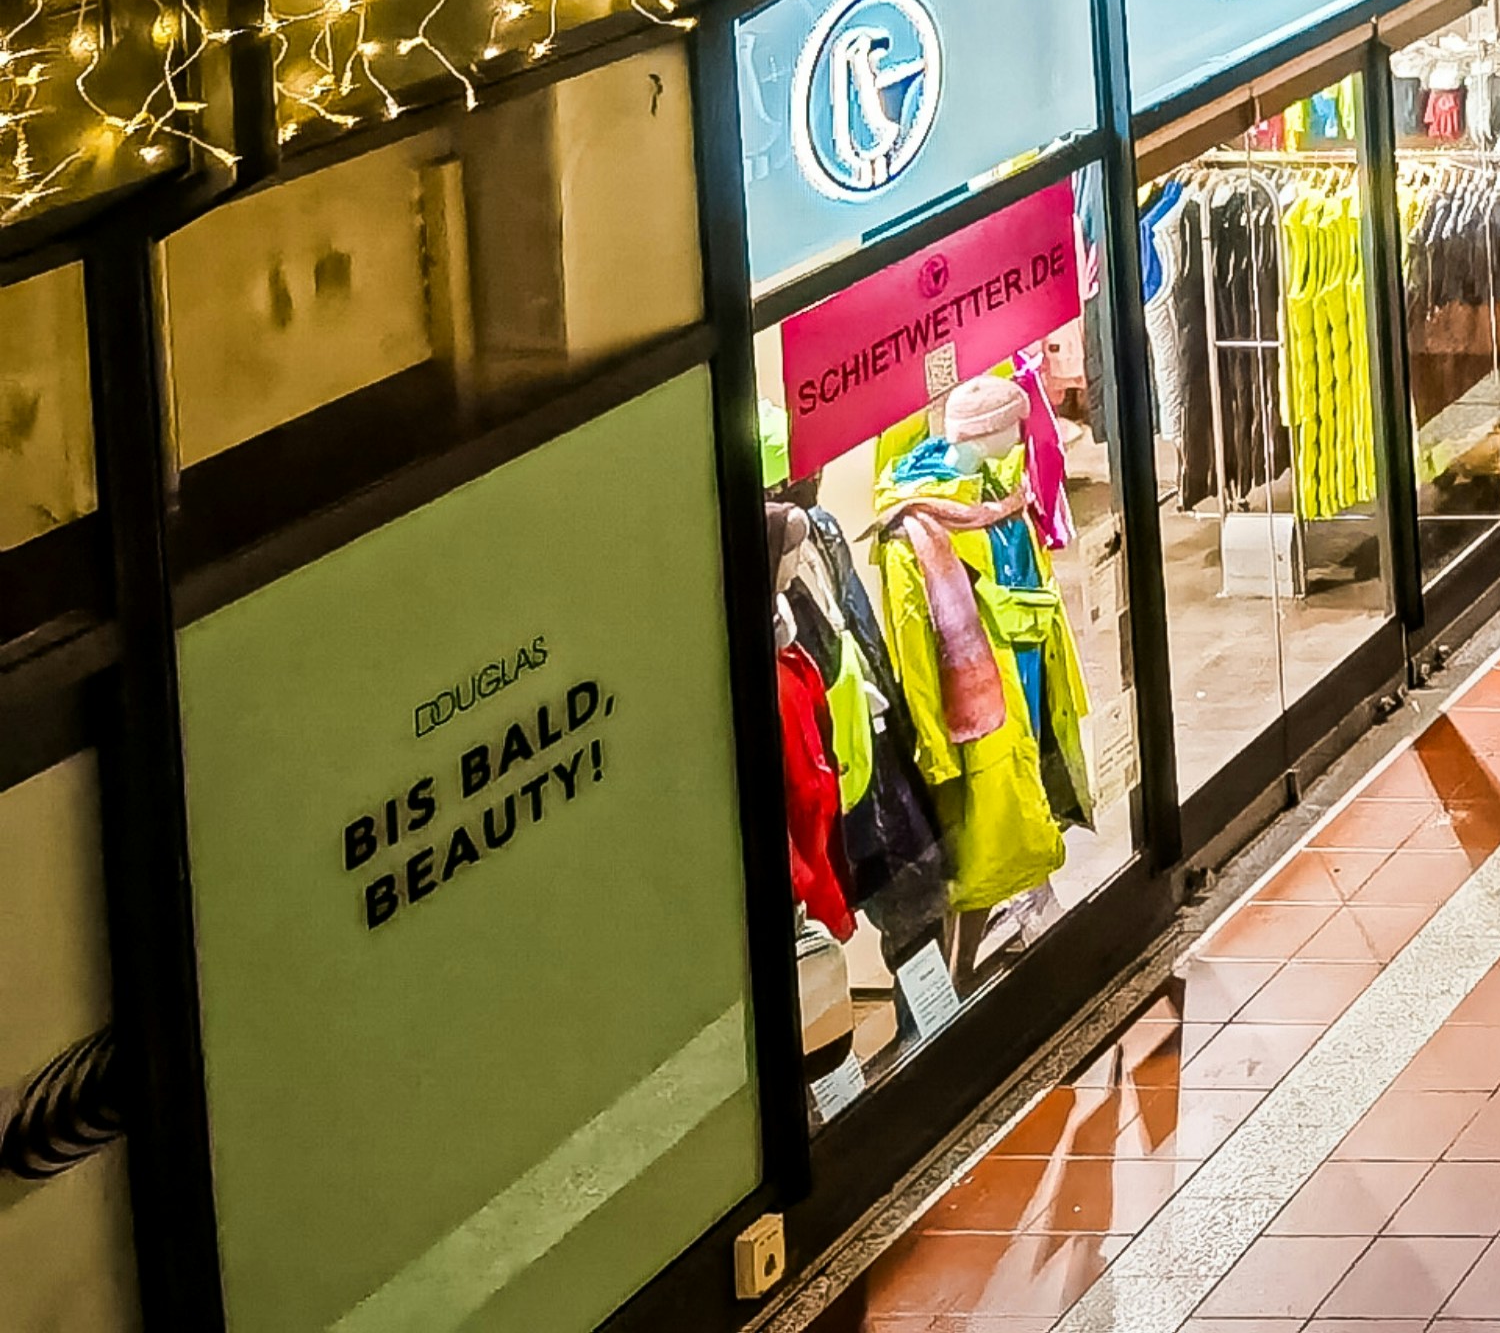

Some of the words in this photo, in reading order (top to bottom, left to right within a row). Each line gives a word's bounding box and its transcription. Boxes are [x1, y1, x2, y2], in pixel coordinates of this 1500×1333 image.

[797, 242, 1066, 416] SCHIETWETTER.DE
[344, 776, 436, 872] BIS
[461, 680, 615, 800] BALD,
[414, 635, 549, 739] DOUGLAS
[364, 738, 603, 931] BEAUTY!
